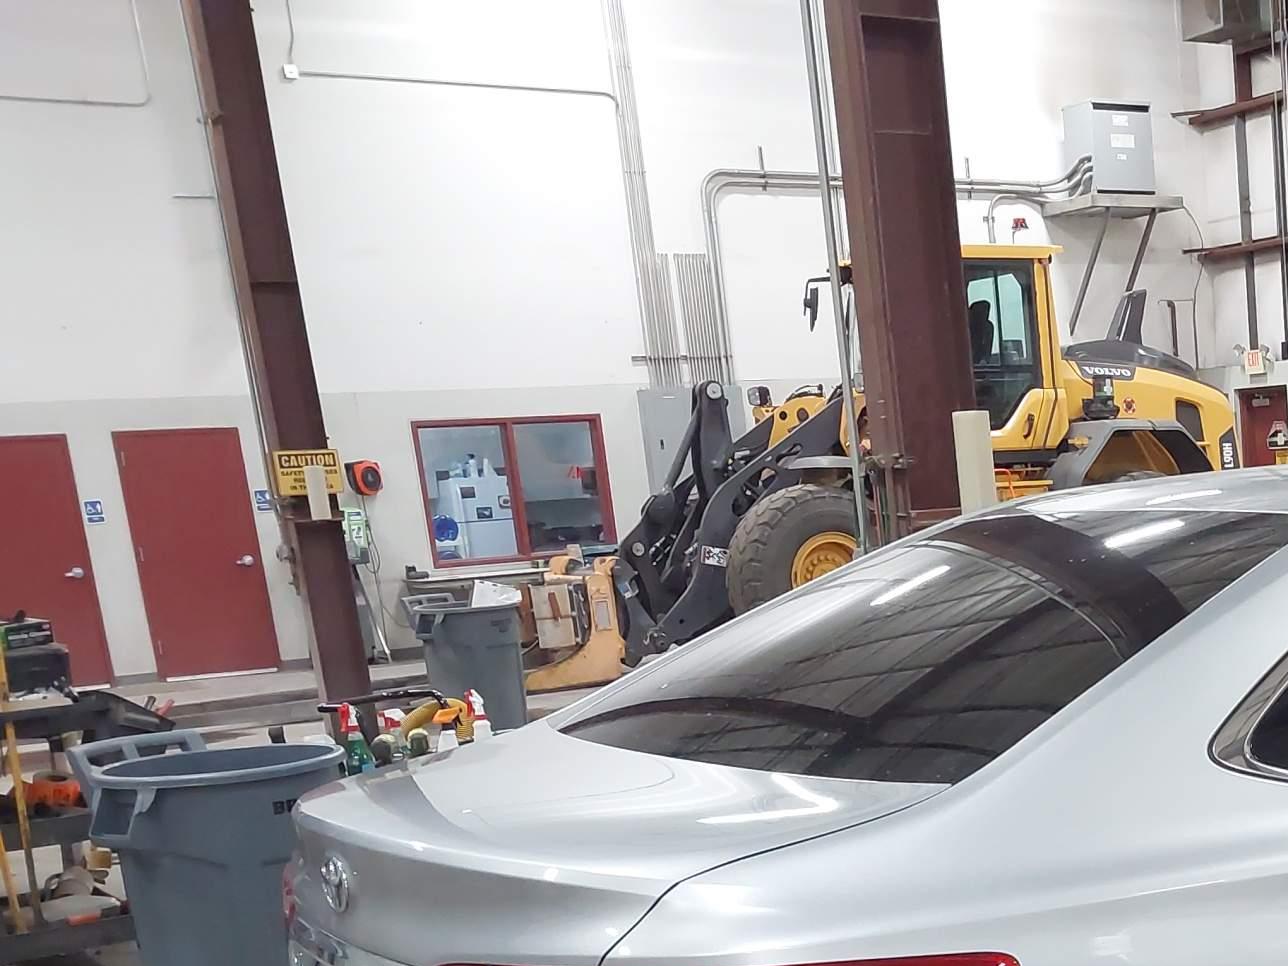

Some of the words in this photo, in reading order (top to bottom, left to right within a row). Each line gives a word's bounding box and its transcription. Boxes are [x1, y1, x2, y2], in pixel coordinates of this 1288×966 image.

[1082, 367, 1131, 376] VOLVO
[281, 454, 334, 467] CAUTION
[1223, 442, 1234, 468] L90H
